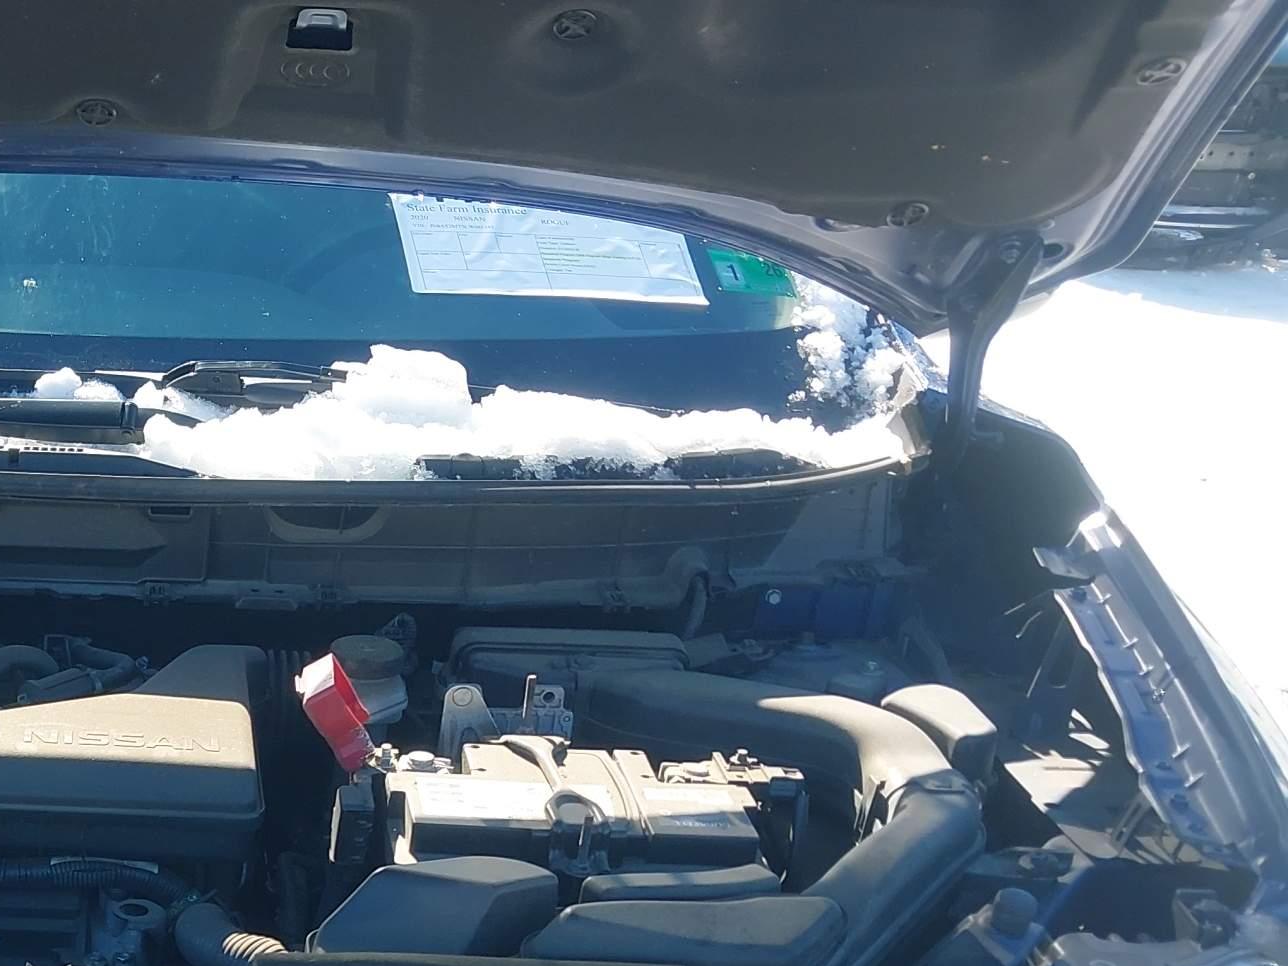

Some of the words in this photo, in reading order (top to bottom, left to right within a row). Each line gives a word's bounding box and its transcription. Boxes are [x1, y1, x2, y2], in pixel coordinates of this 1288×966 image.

[407, 203, 436, 212] State
[438, 204, 469, 213] Farm
[472, 205, 528, 215] Insurance
[726, 263, 739, 281] 1
[763, 262, 783, 277] 26
[23, 727, 221, 752] NISSAN
